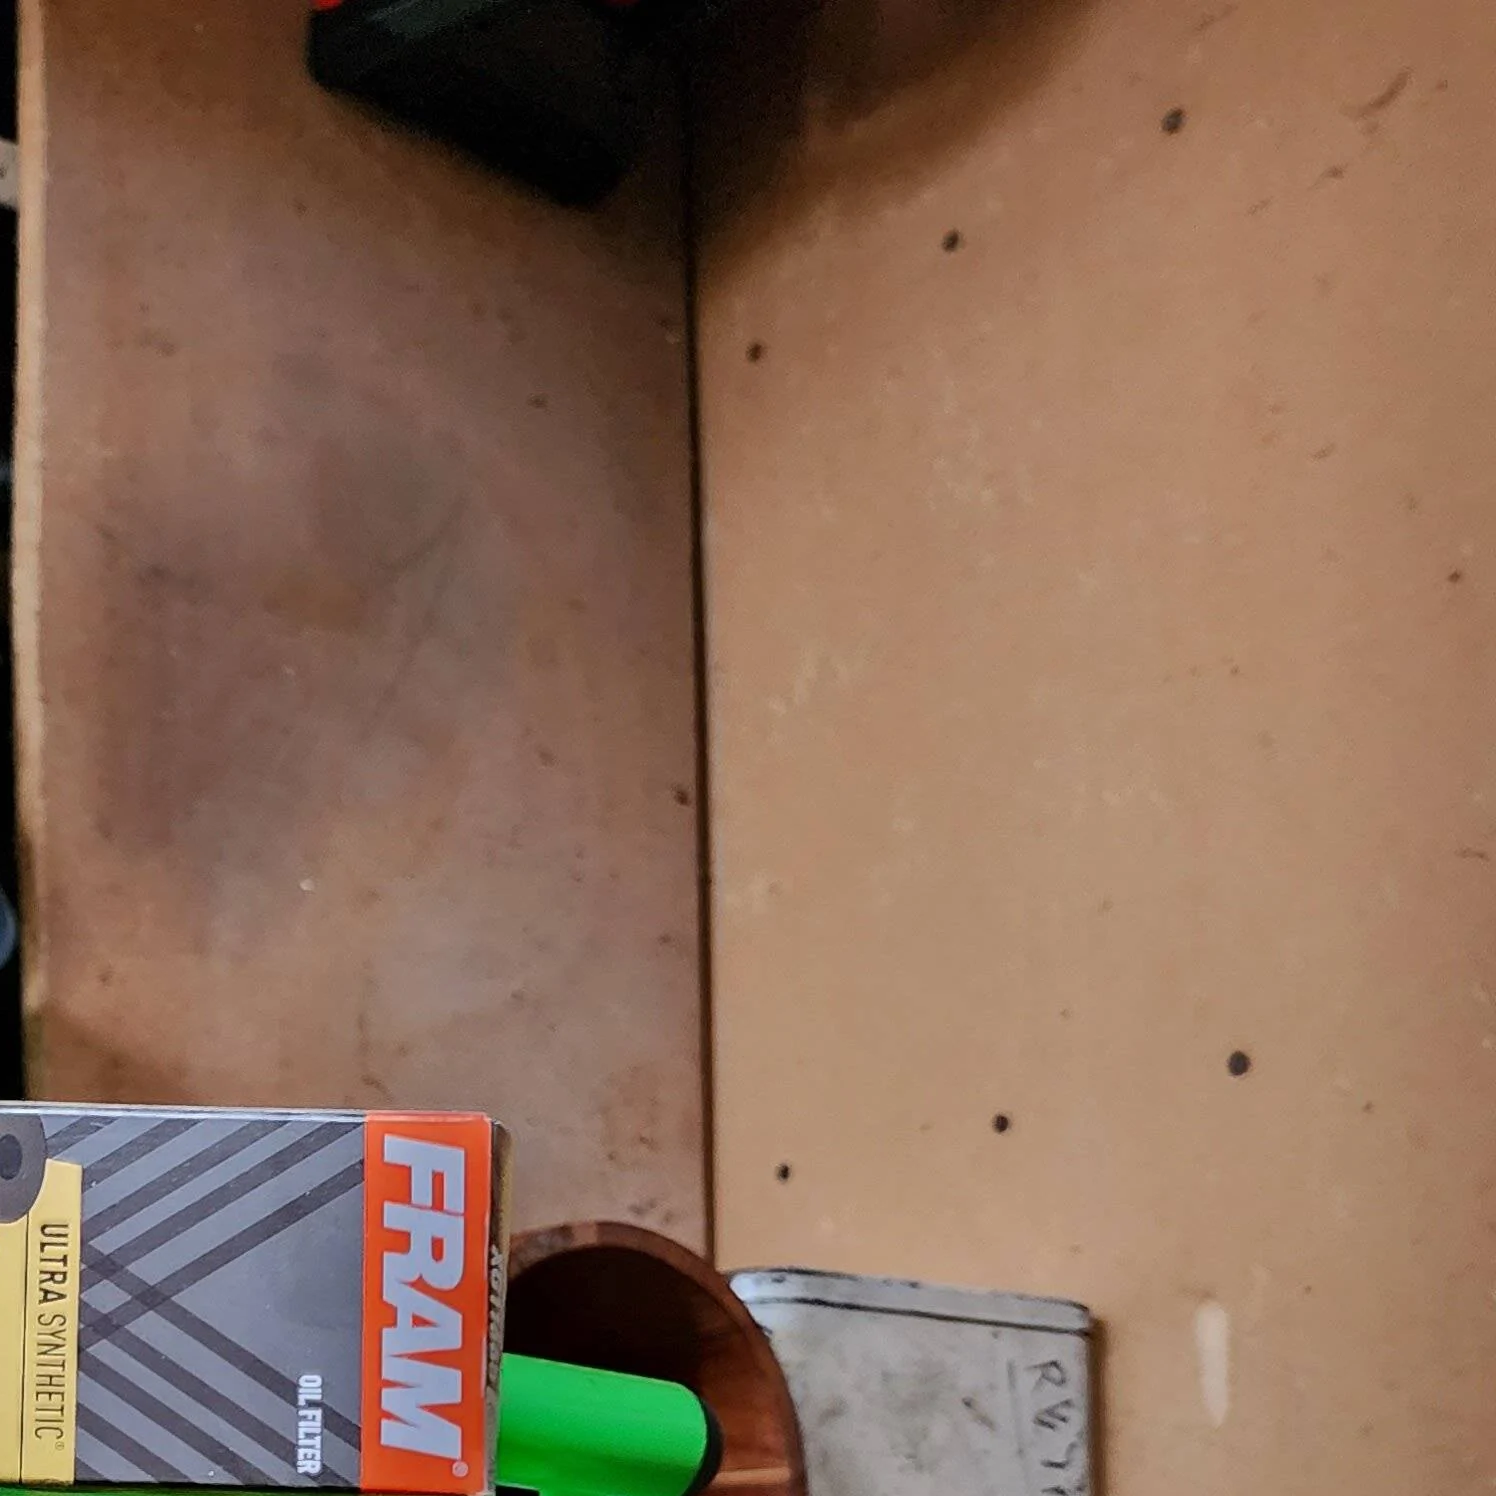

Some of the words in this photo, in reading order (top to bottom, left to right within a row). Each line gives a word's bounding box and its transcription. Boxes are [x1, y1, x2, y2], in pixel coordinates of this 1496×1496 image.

[37, 1223, 69, 1306] ULTRA
[381, 1133, 466, 1462] FRAM
[34, 1313, 68, 1440] SYNTHETIC
[298, 1374, 323, 1406] OIL
[296, 1408, 323, 1476] FILTER
